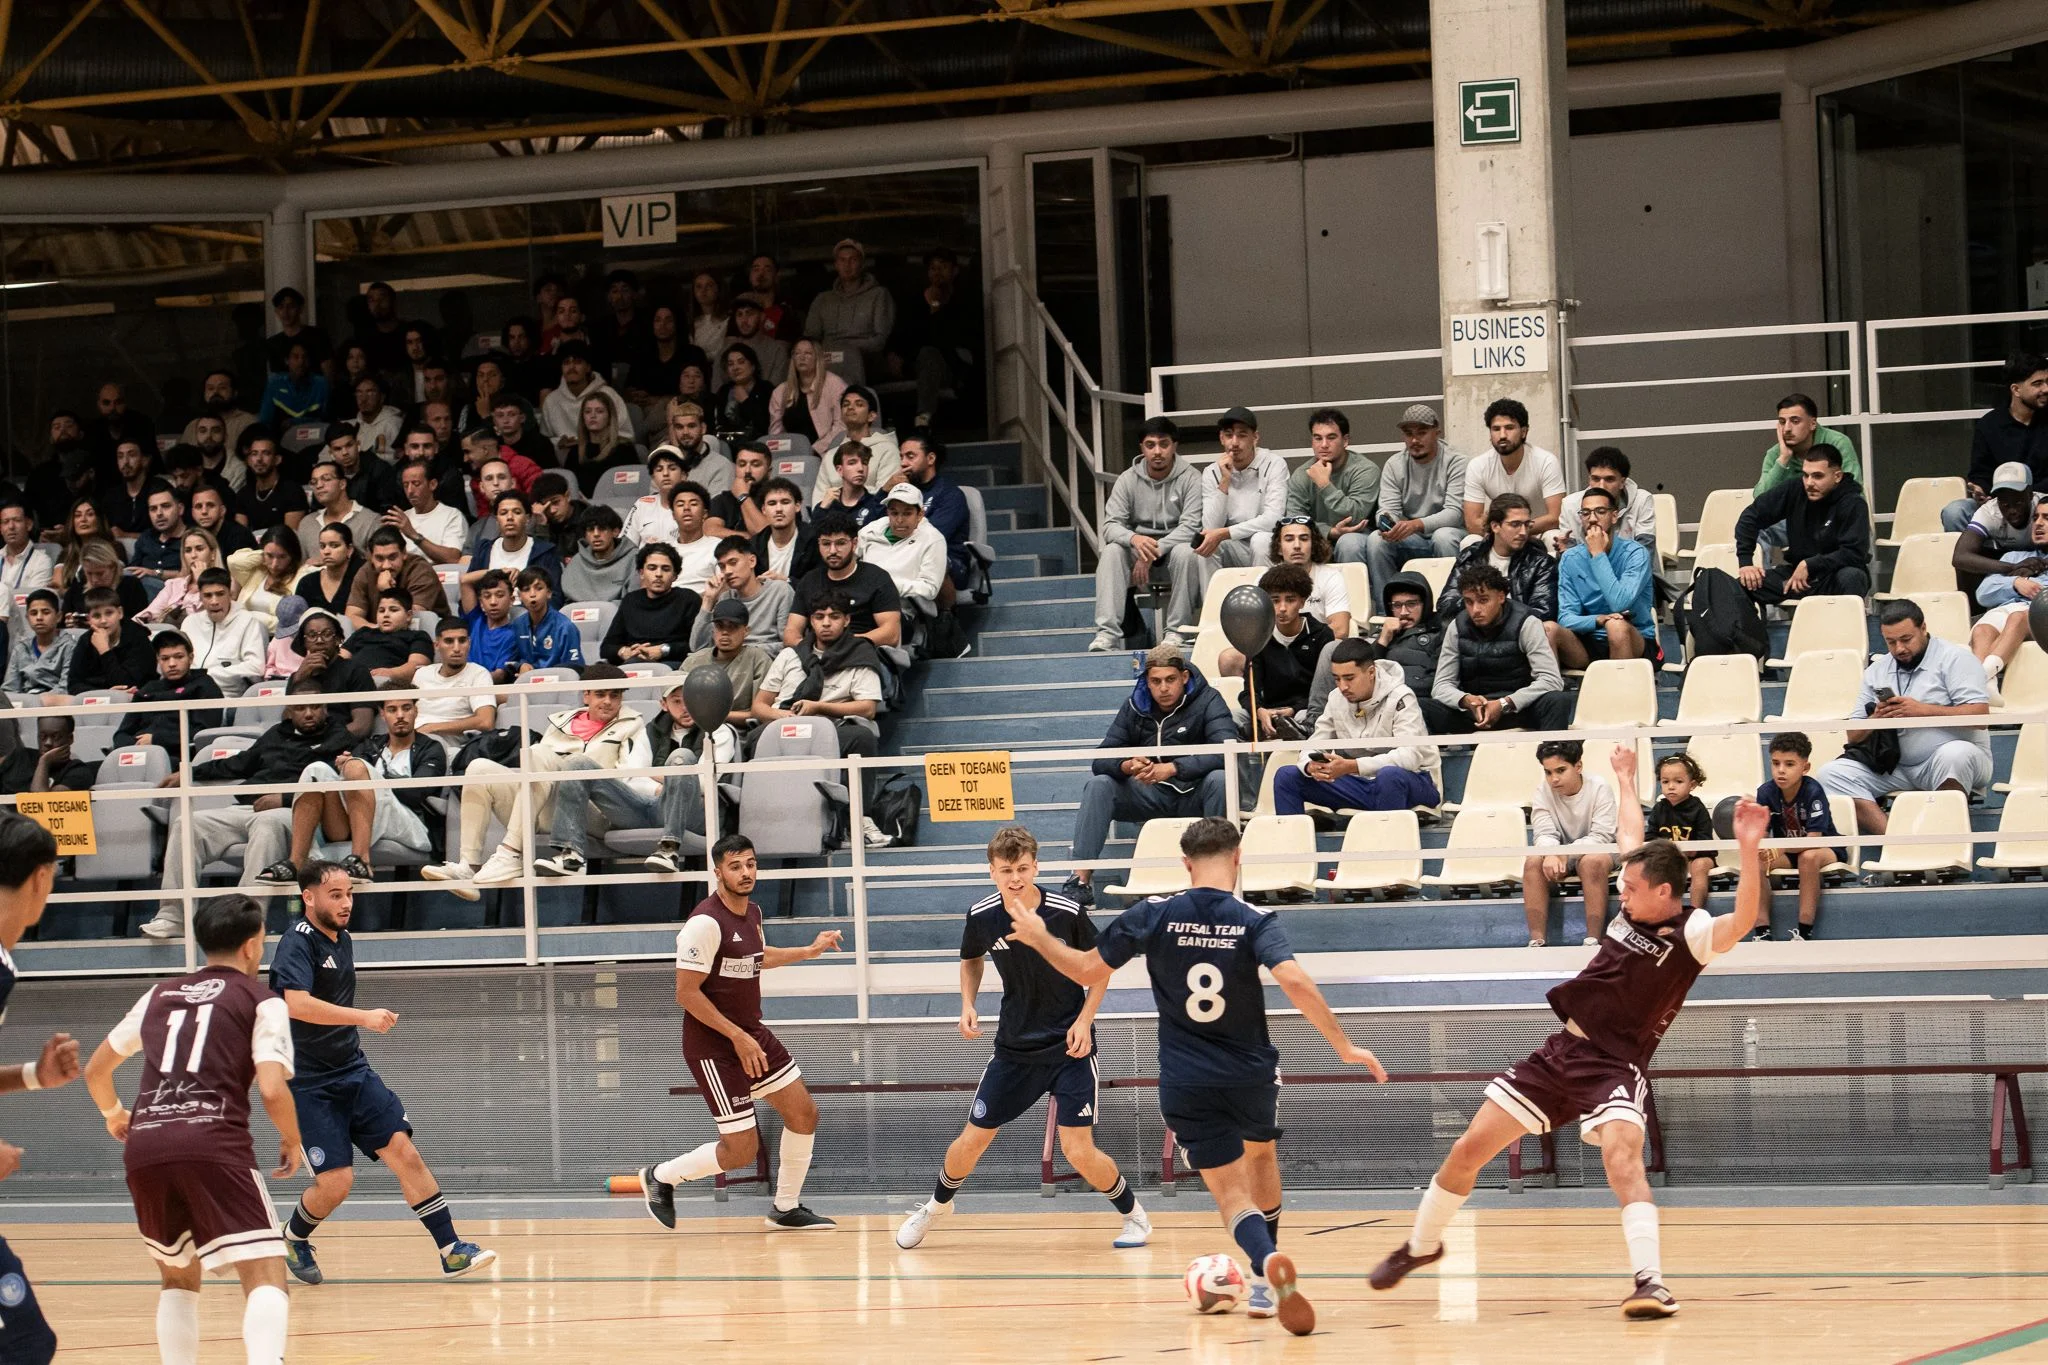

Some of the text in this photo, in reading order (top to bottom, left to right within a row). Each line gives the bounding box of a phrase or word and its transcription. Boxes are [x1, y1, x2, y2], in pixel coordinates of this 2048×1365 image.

[607, 201, 671, 238] VIP
[1452, 315, 1545, 341] BUSINESS
[1473, 345, 1526, 369] LINKS
[929, 761, 1006, 776] GEEN TOEGANG
[960, 780, 979, 793] TOT
[20, 800, 88, 814] GEEN TOEGANG
[938, 797, 1005, 811] DEZE TRIBUNE
[48, 817, 64, 830] TOT
[1166, 922, 1246, 936] FUTSAL TEAM
[1185, 962, 1226, 1022] 8
[160, 1004, 213, 1073] 11
